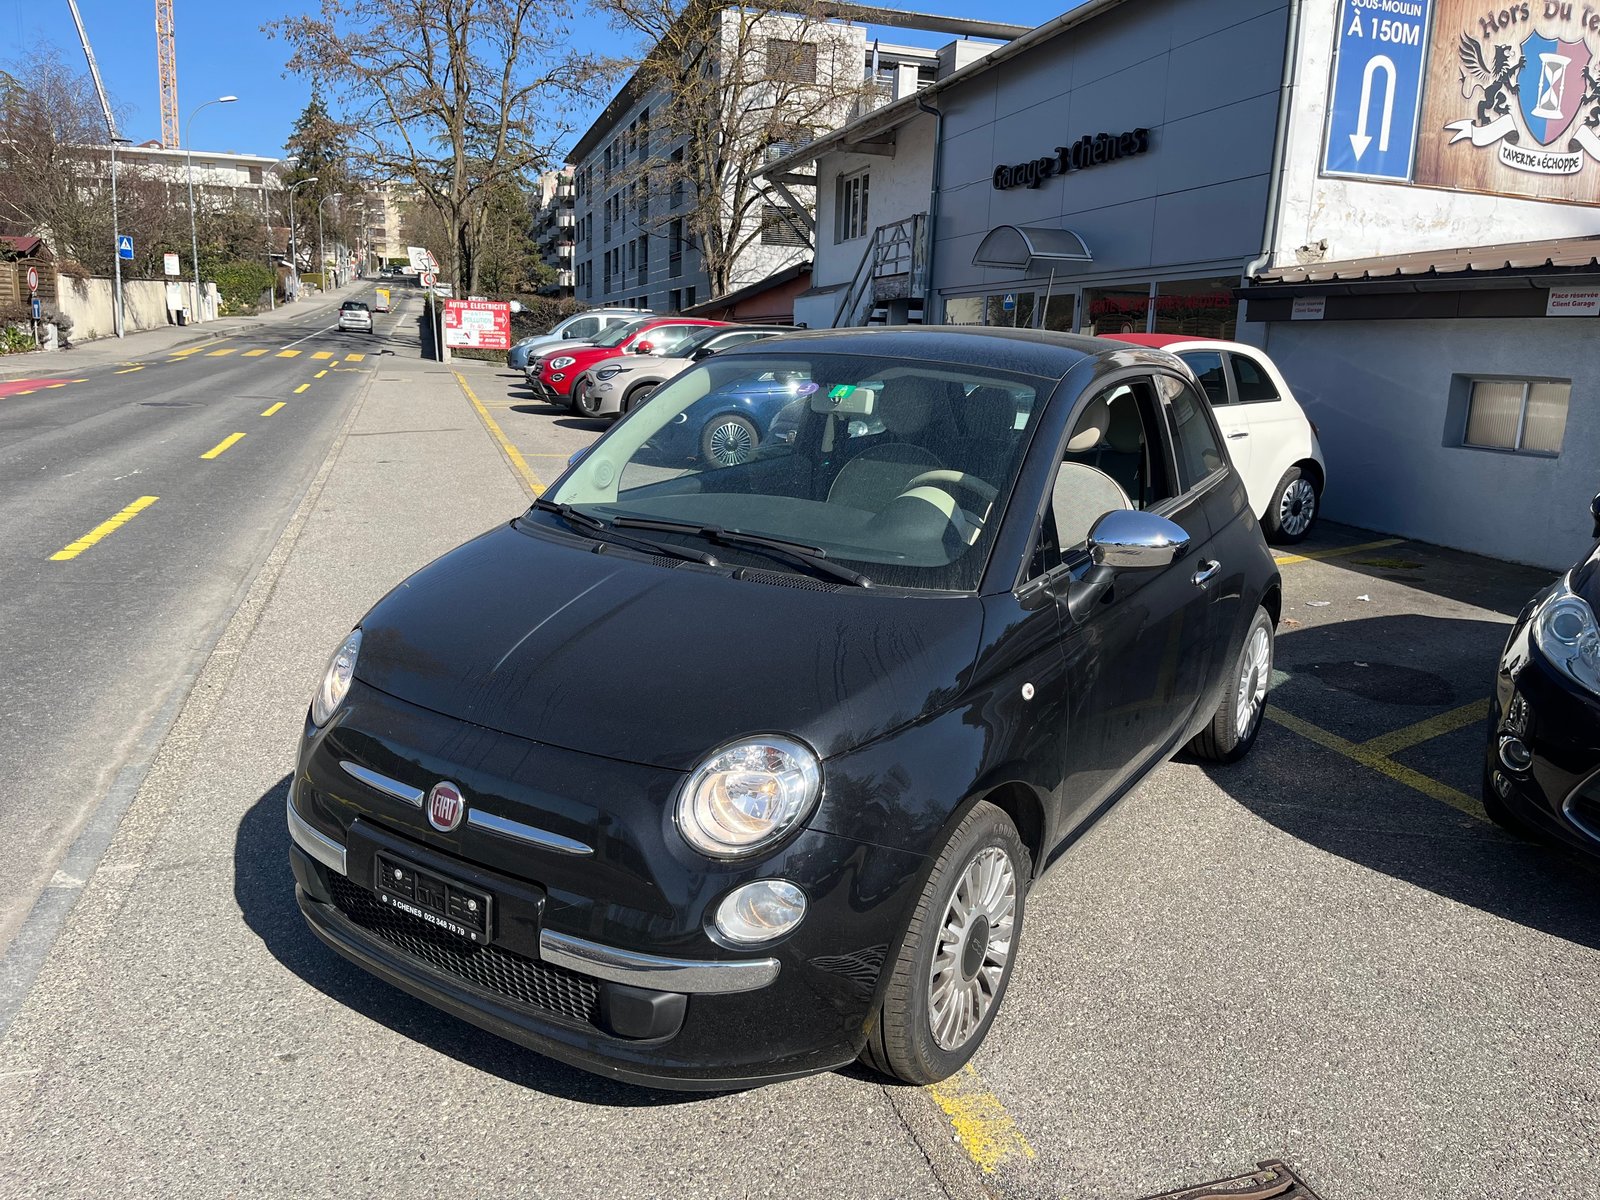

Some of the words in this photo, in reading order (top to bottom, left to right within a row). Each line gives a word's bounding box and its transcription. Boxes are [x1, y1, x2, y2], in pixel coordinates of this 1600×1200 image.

[1351, 0, 1422, 17] SOUS-MOULIN
[1479, 2, 1530, 38] Hors
[1543, 0, 1573, 21] Du
[1581, 3, 1600, 32] Te
[1347, 8, 1363, 38] À
[1371, 18, 1420, 46] 150M
[992, 157, 1053, 190] Garage
[1052, 147, 1069, 174] 3
[1070, 128, 1150, 169] Chênes
[1503, 147, 1537, 167] TAVERNE
[1542, 154, 1580, 172] ÉCHOPPE
[448, 301, 468, 309] AUTOS
[470, 302, 507, 311] ELECTRICITE
[1571, 300, 1596, 308] Garage
[434, 795, 457, 821] FIAT
[391, 899, 397, 907] 3
[397, 901, 422, 918] CHENES
[423, 913, 436, 924] 022
[436, 918, 448, 929] 348
[448, 923, 457, 932] 78
[456, 926, 465, 936] 79
